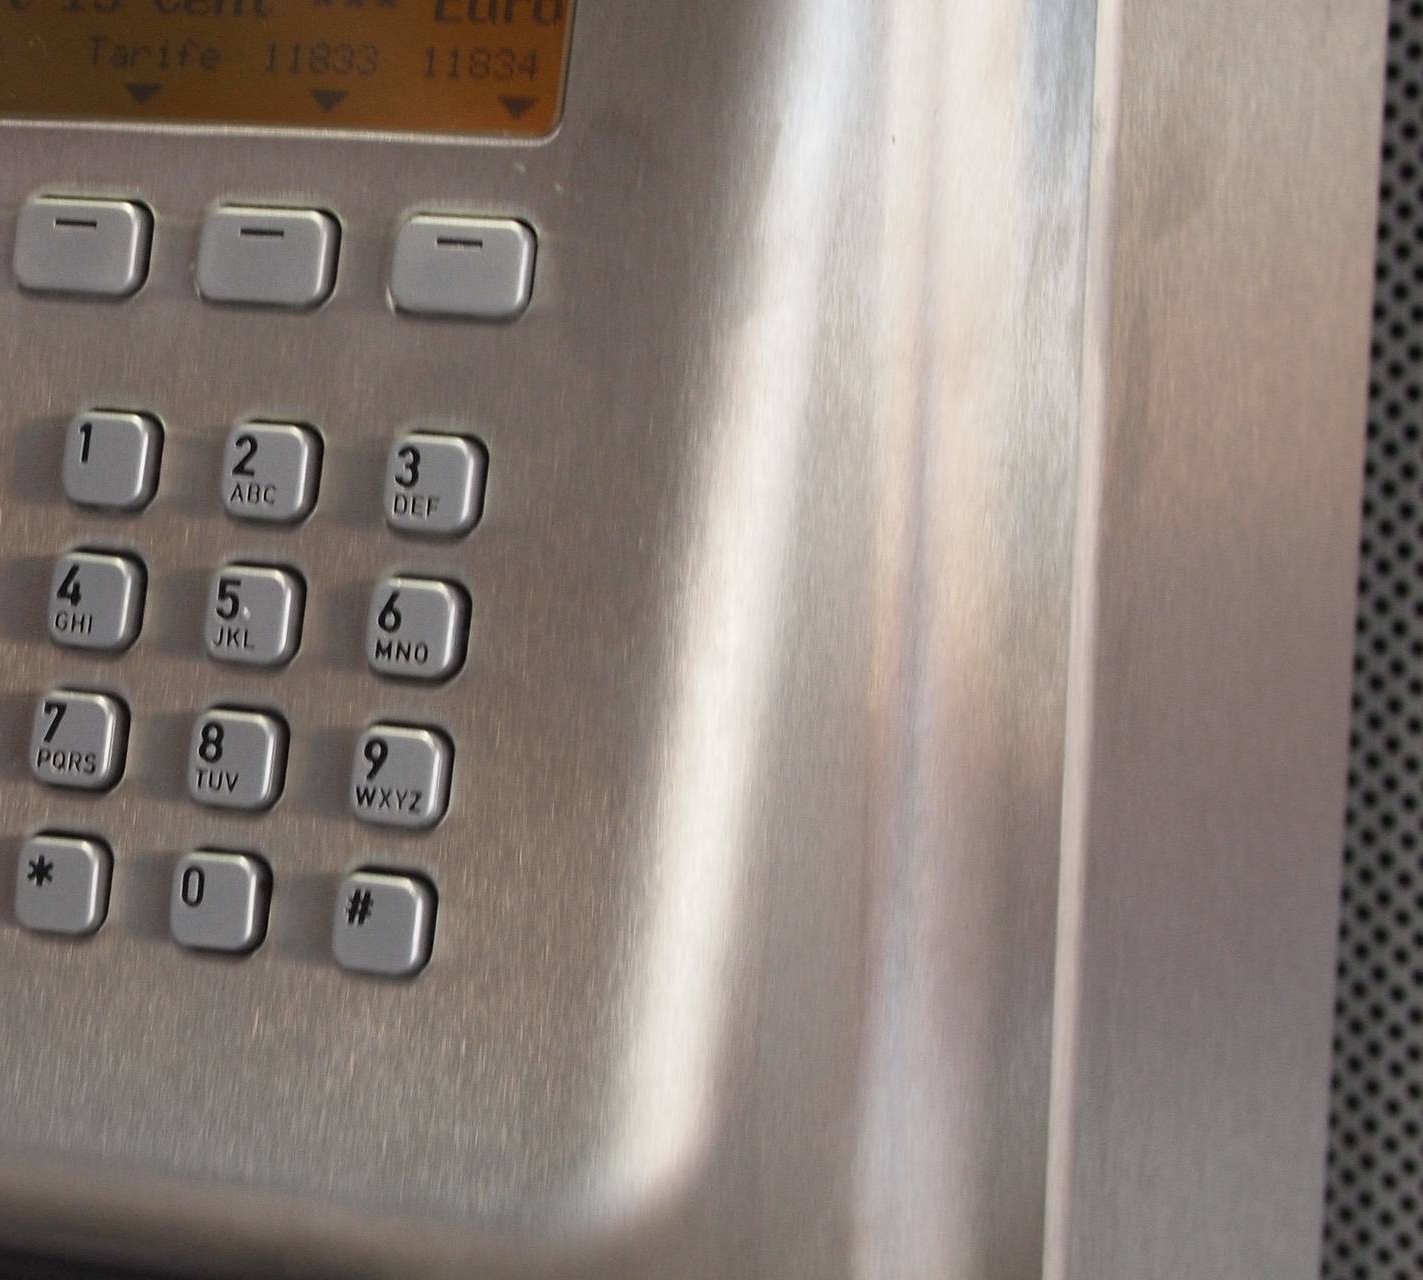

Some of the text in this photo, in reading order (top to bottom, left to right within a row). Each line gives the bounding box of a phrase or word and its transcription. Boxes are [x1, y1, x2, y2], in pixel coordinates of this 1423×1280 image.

[90, 34, 223, 71] Tarife
[264, 41, 379, 76] 11833
[423, 45, 540, 80] 11834
[79, 421, 92, 464] 1
[232, 434, 259, 477] 2
[393, 445, 420, 488] 3
[230, 483, 277, 506] ABC
[392, 494, 440, 517] DEF
[56, 563, 81, 607] 4
[216, 578, 242, 621] 5
[54, 611, 94, 635] GHI
[378, 590, 402, 633] 6
[212, 626, 256, 650] JKL
[374, 639, 429, 665] MNO
[44, 701, 67, 743] 7
[198, 721, 225, 763] 8
[35, 750, 97, 775] PQRS
[363, 737, 389, 781] 9
[194, 768, 239, 794] TUV
[354, 786, 423, 813] WXYZ
[180, 866, 206, 908] 0
[345, 888, 375, 926] #
